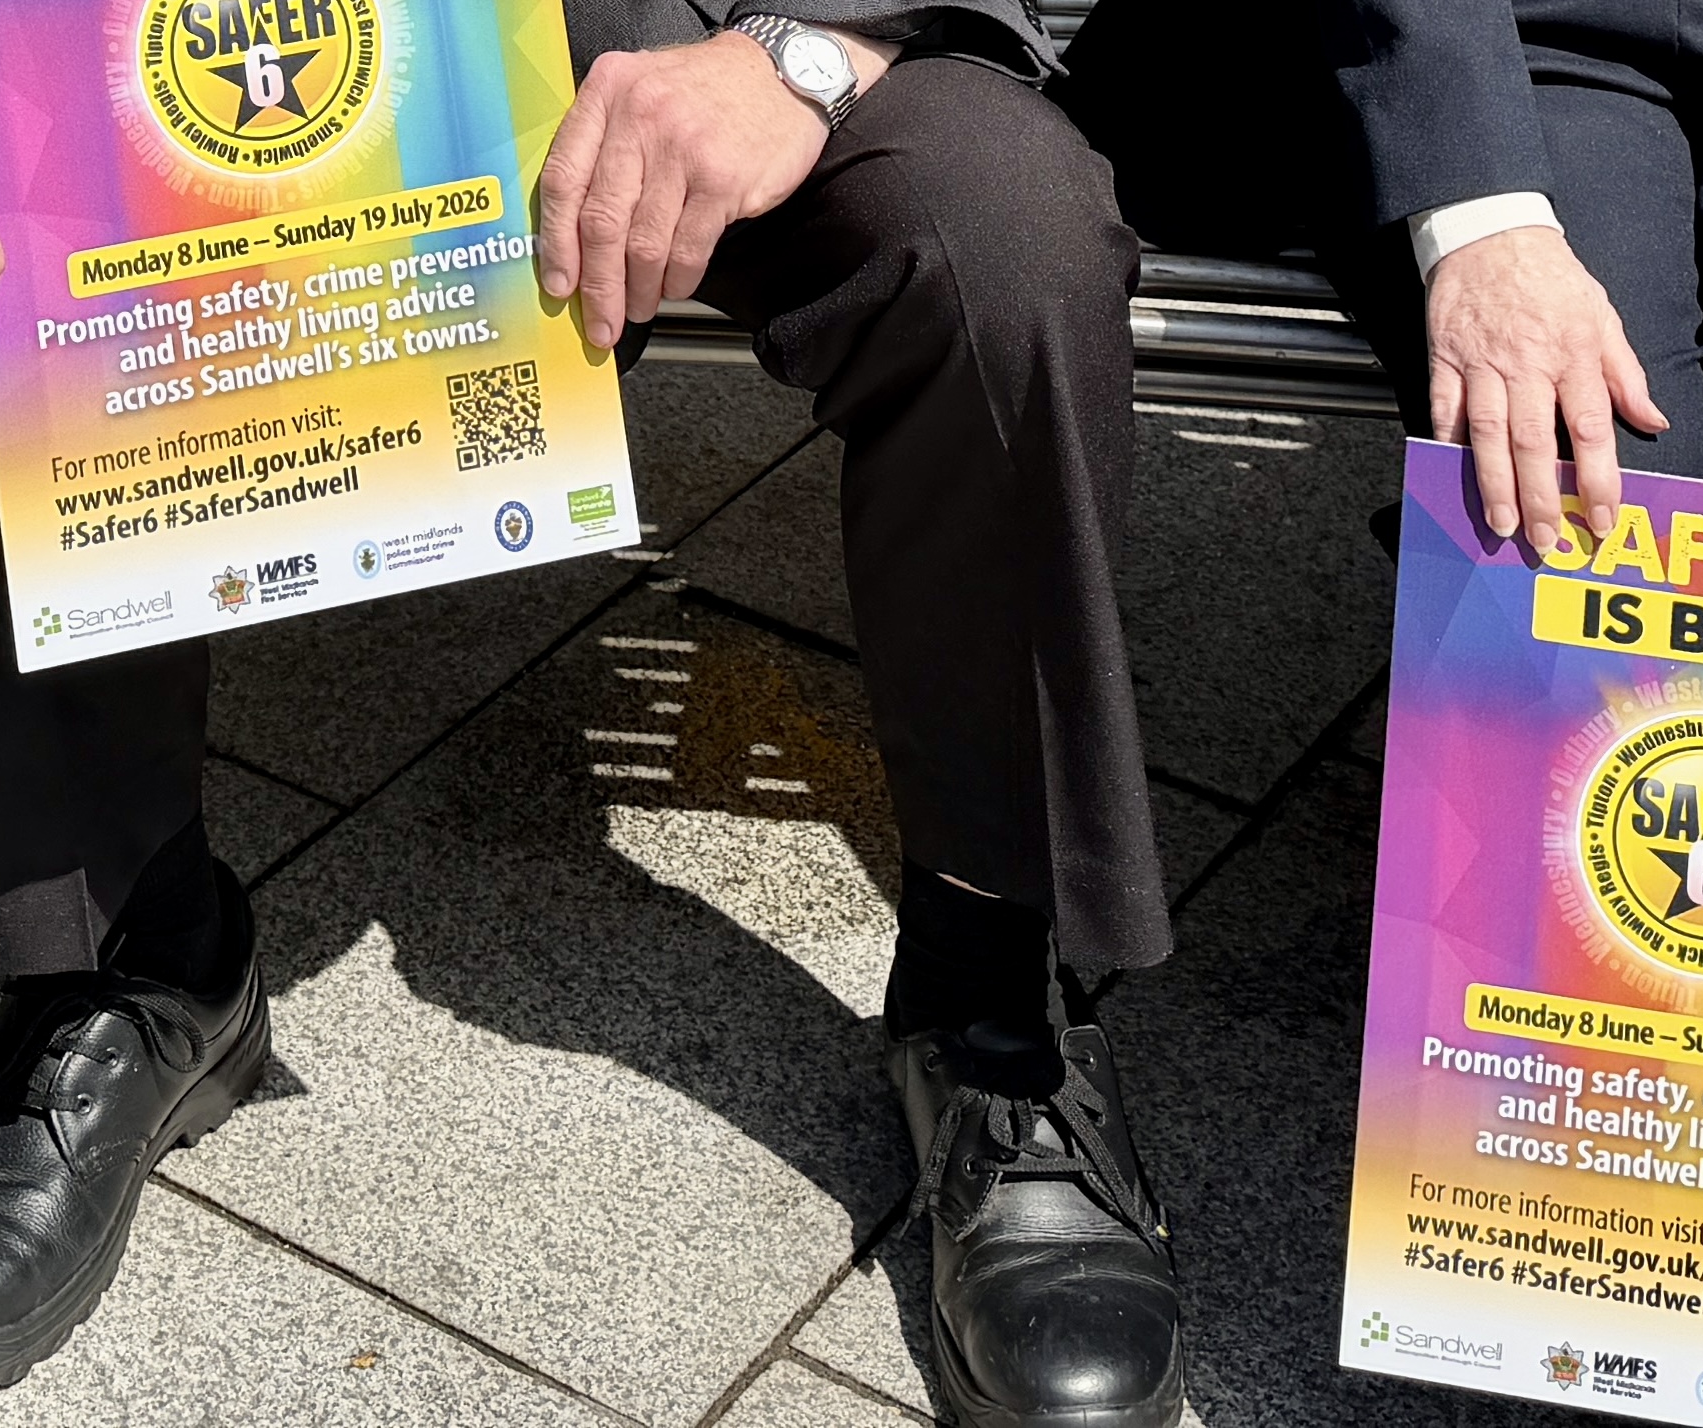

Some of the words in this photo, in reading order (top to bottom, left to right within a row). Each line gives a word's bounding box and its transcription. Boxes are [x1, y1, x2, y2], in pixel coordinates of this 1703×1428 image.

[243, 43, 285, 108] 6
[82, 249, 174, 285] Monday
[177, 242, 193, 267] 8
[196, 237, 249, 264] June
[273, 214, 356, 249] Sunday
[360, 206, 387, 231] 19
[390, 198, 433, 228] July
[436, 186, 490, 219] 2026
[36, 298, 194, 350] Promoting
[199, 279, 298, 318] safety,
[304, 263, 383, 298] crime
[119, 333, 176, 373] and
[180, 316, 292, 361] healthy
[297, 302, 379, 338] living
[385, 283, 475, 321] advice
[105, 376, 195, 415] across
[358, 337, 398, 365] six
[402, 318, 500, 356] towns.
[51, 456, 87, 483] For
[93, 445, 151, 475] more
[156, 417, 286, 462] information
[291, 405, 342, 434] visit:
[55, 419, 422, 517] www.sandwell.gov.uk/safer6
[60, 507, 158, 552] #Safer6
[164, 465, 359, 529] #SaferSandwell
[256, 552, 318, 582] WMFS
[67, 590, 173, 630] Sandwell
[1582, 588, 1644, 644] IS
[1404, 1243, 1505, 1282] #Safer6
[1395, 1325, 1503, 1361] Sandwell
[1594, 1351, 1658, 1380] WMFS
